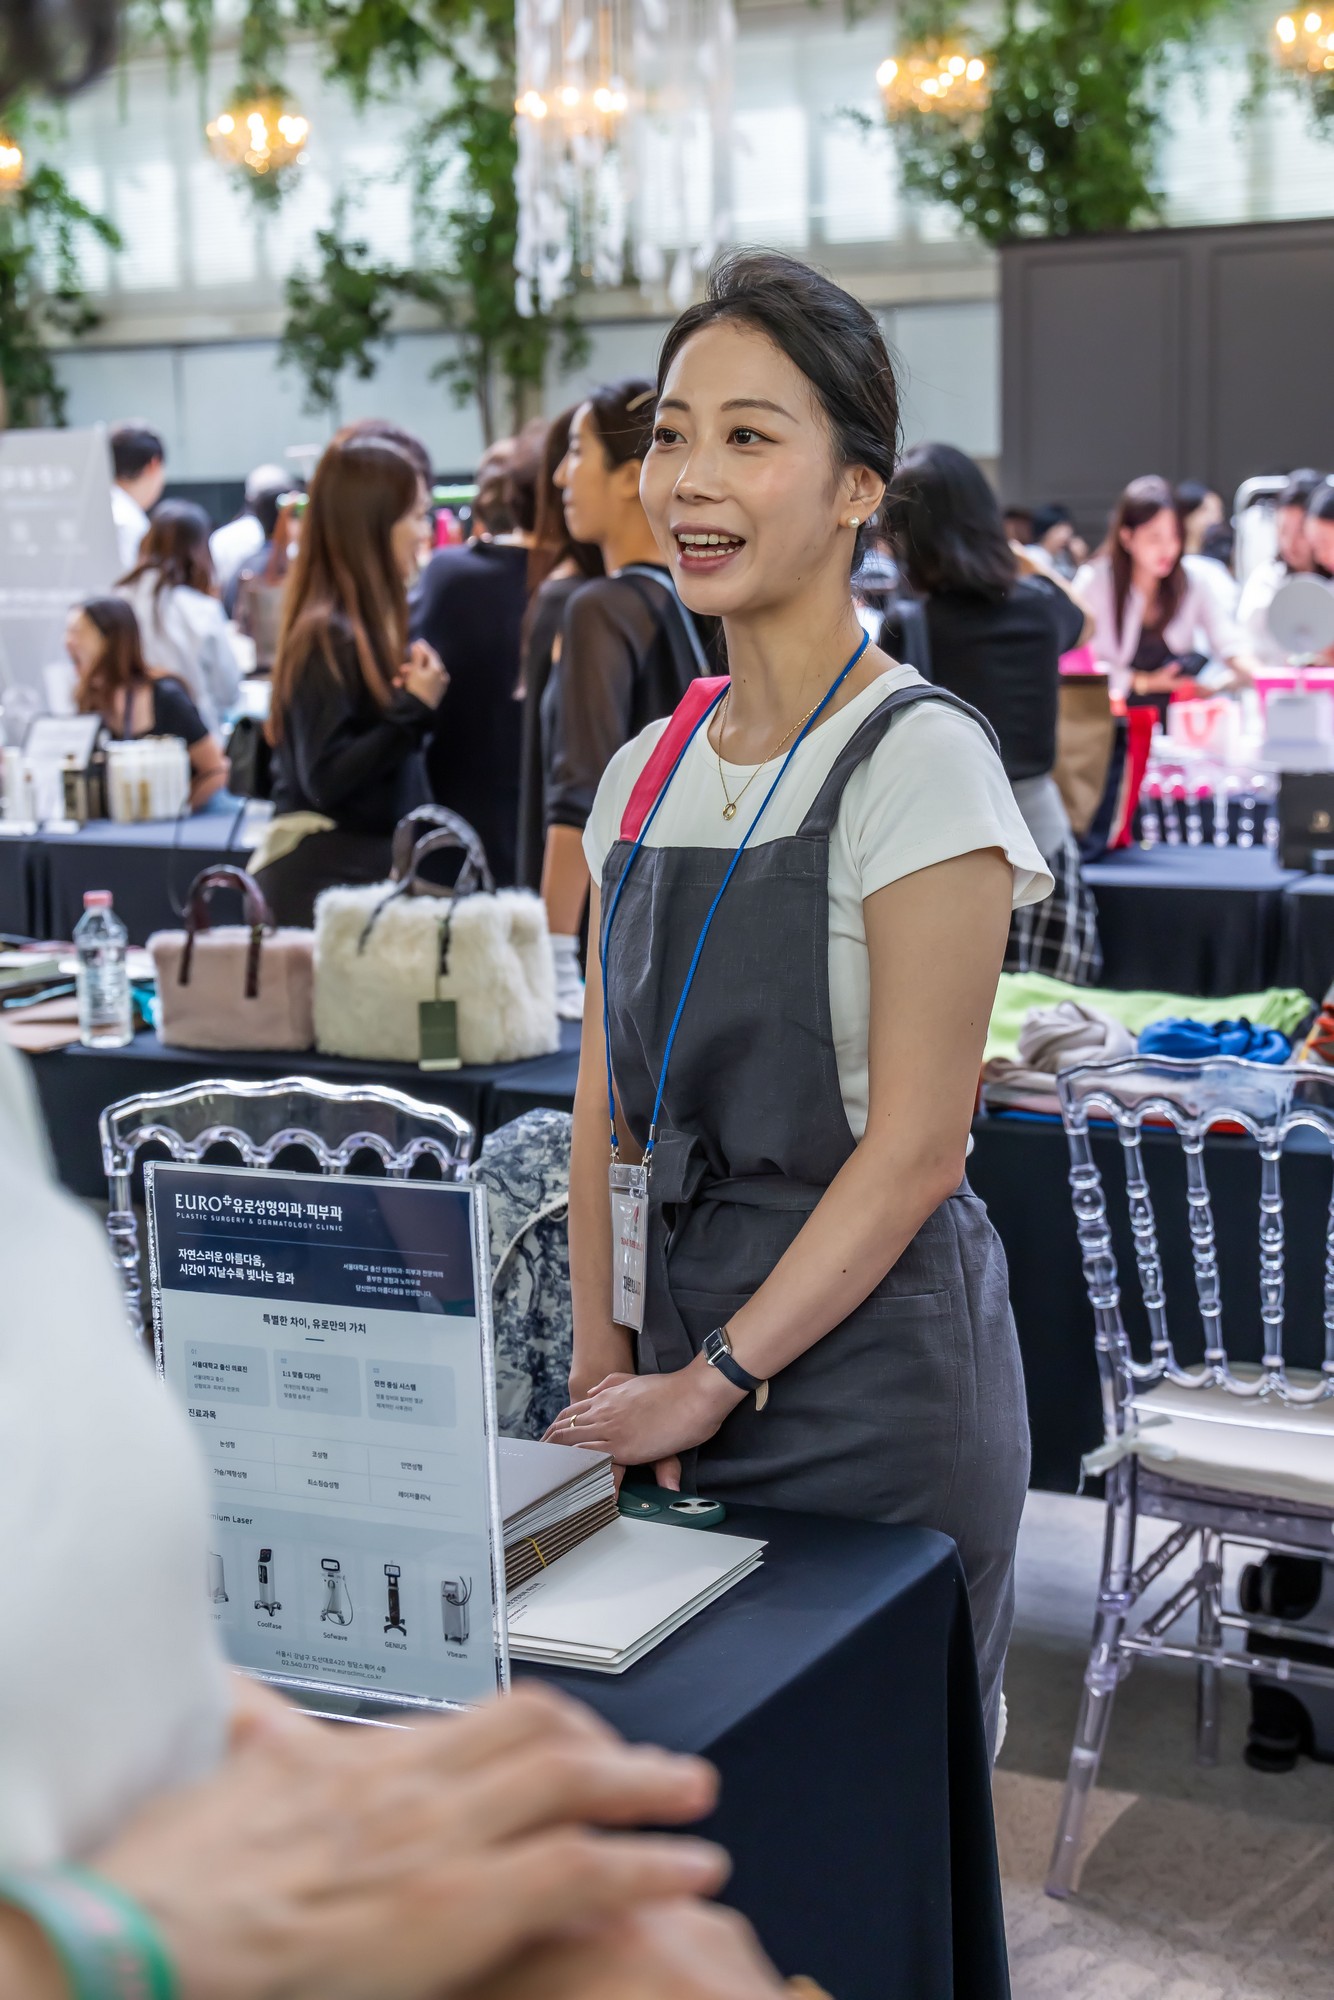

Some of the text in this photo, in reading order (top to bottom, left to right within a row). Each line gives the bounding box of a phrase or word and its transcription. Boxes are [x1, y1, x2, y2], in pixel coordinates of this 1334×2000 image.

[175, 1194, 222, 1212] EURO
[232, 1199, 343, 1222] 유로성형외과·피부과
[176, 1212, 207, 1220] PLASTIC
[211, 1215, 245, 1224] SURGERY
[257, 1219, 312, 1229] DERMATOLOGY
[316, 1224, 343, 1232] CLINIC
[178, 1248, 266, 1268] 자연스러운 아름다움,
[343, 1263, 368, 1272] 서울대학교
[180, 1264, 295, 1284] 시간이 지날수록 빛나는 결과
[262, 1314, 366, 1334] 특별한 차이, 유로만의 가치
[192, 1361, 248, 1373] 서울대학교 출신 의료진
[304, 1373, 321, 1381] 디자인
[399, 1383, 416, 1391] 시스템
[188, 1408, 216, 1420] 진료과목
[220, 1440, 235, 1449] 눈성형
[312, 1450, 328, 1459] 코성형
[232, 1515, 253, 1524] Laser
[257, 1620, 282, 1630] Coolfase
[323, 1632, 348, 1641] Sofwave
[384, 1641, 407, 1650] GENIUS
[275, 1650, 292, 1658] 서울시
[293, 1653, 310, 1661] 강남구
[447, 1651, 468, 1659] Vbeam
